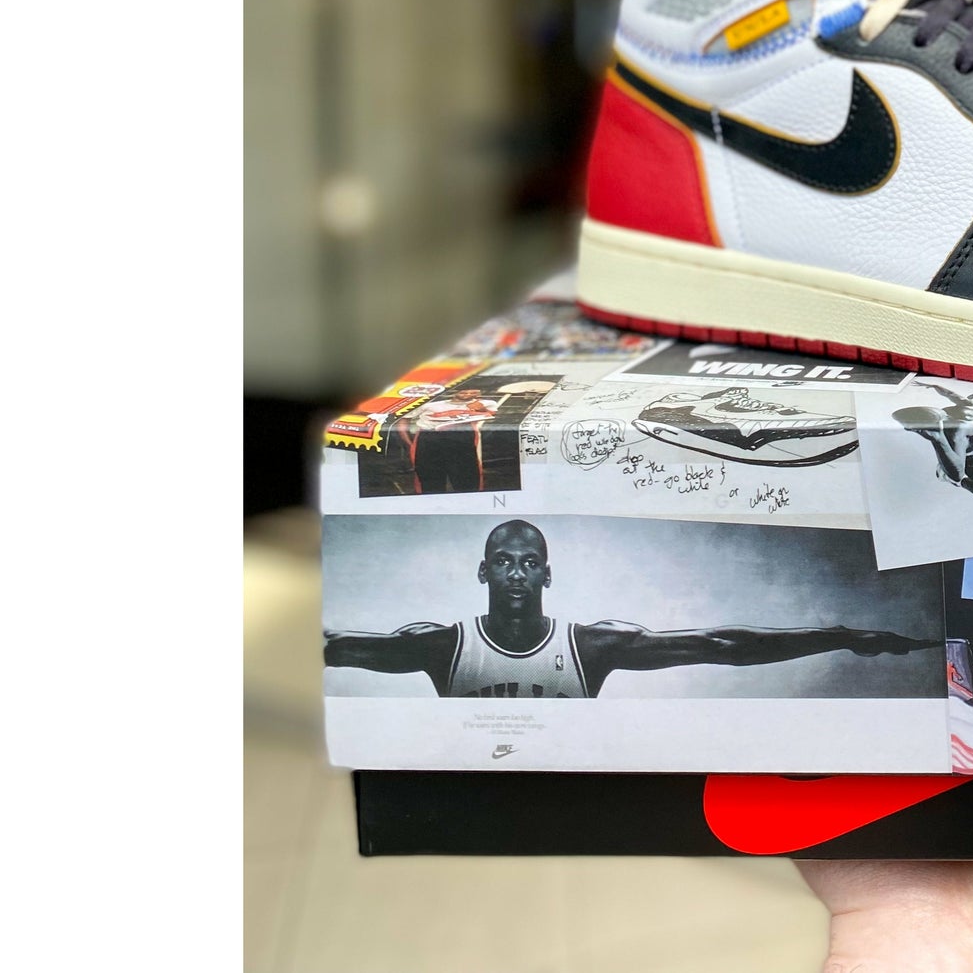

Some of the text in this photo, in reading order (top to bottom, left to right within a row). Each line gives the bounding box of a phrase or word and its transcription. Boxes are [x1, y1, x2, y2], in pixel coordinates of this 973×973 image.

[688, 360, 854, 380] WING IT.
[664, 475, 680, 490] go
[685, 464, 714, 481] black
[677, 480, 710, 494] white
[729, 488, 740, 498] or
[493, 494, 506, 508] N
[749, 483, 775, 509] white
